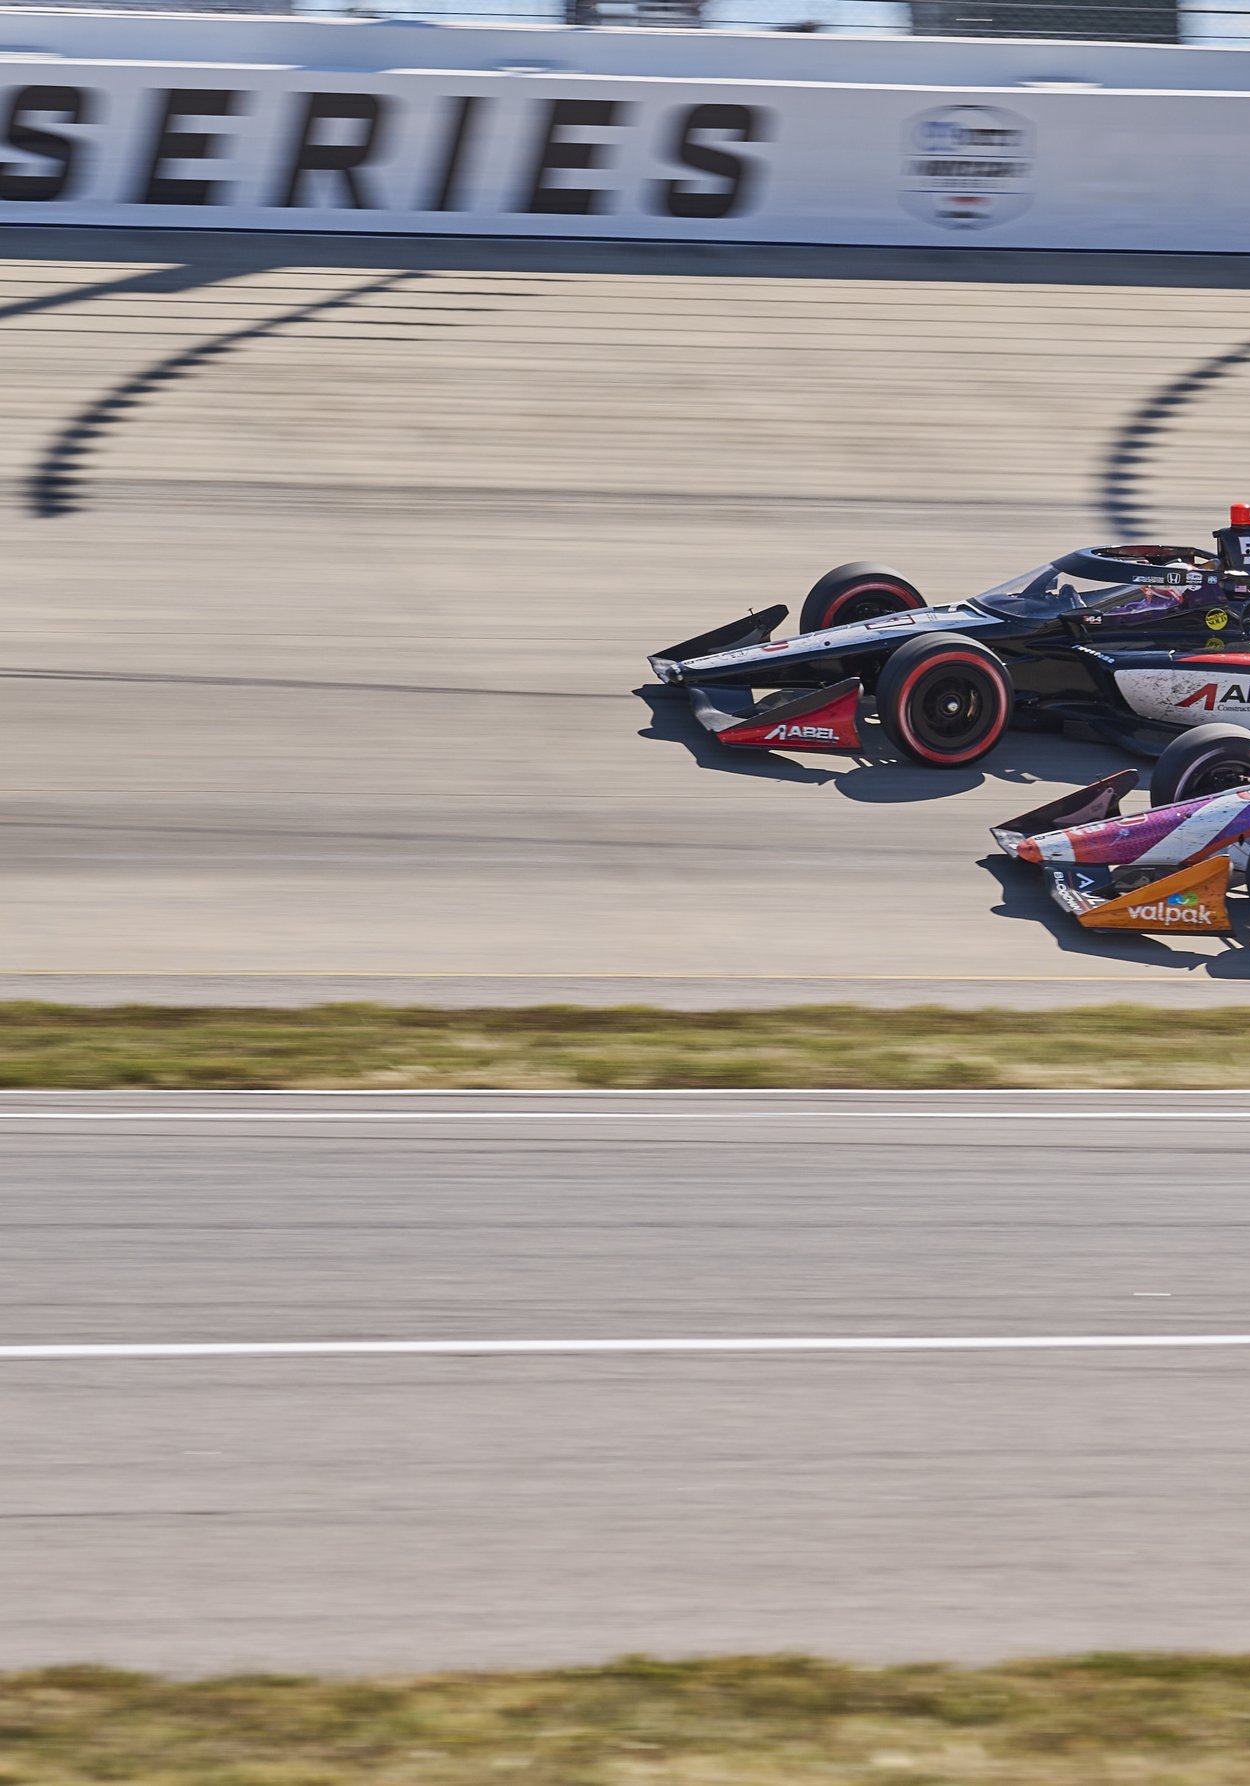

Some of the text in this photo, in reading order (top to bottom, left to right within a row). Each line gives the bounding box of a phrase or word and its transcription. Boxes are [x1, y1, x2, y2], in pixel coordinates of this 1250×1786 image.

[0, 85, 768, 219] SERIES
[787, 725, 840, 740] ABEL
[1127, 901, 1213, 926] valpak
